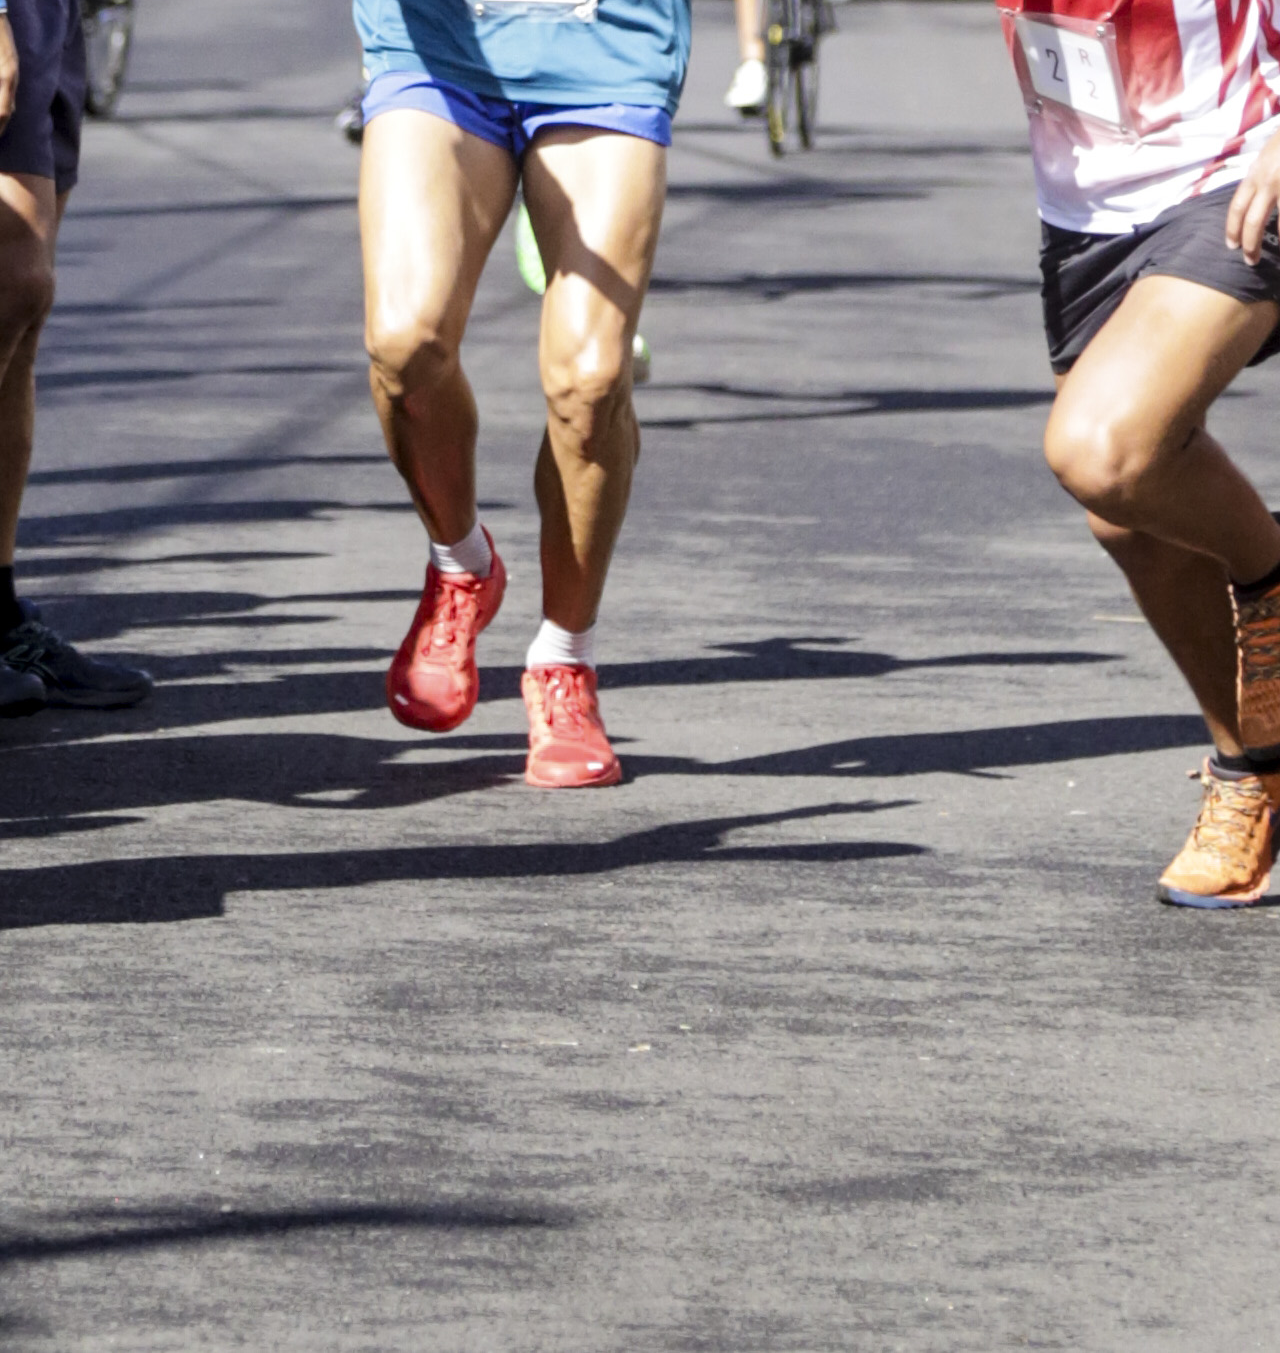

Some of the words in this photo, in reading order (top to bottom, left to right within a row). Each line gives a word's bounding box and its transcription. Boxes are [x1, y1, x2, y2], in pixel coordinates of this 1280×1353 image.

[1044, 47, 1065, 83] 2
[1077, 47, 1093, 68] R
[1086, 79, 1100, 100] 2
